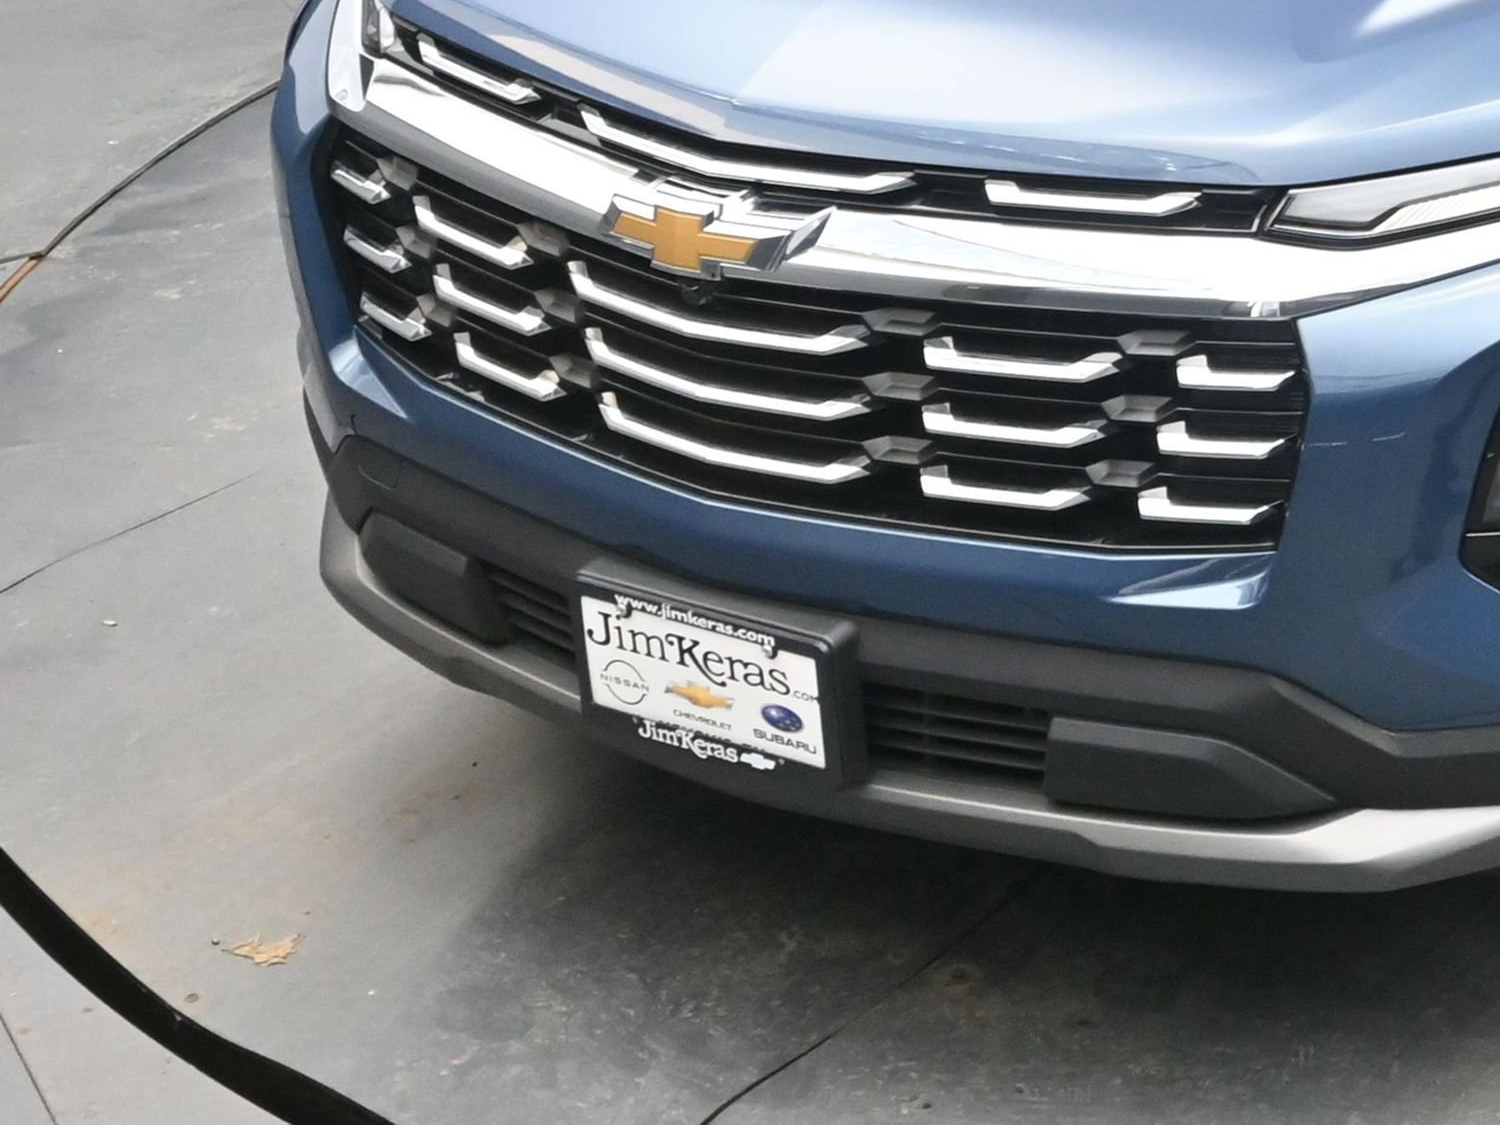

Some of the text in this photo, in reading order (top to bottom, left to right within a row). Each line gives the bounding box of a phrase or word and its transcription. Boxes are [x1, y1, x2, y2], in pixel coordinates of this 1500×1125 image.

[614, 593, 776, 647] www.jimkeras.com
[600, 673, 650, 692] NISSAN
[673, 708, 732, 731] CHEVROLET
[753, 728, 817, 755] SUBARU
